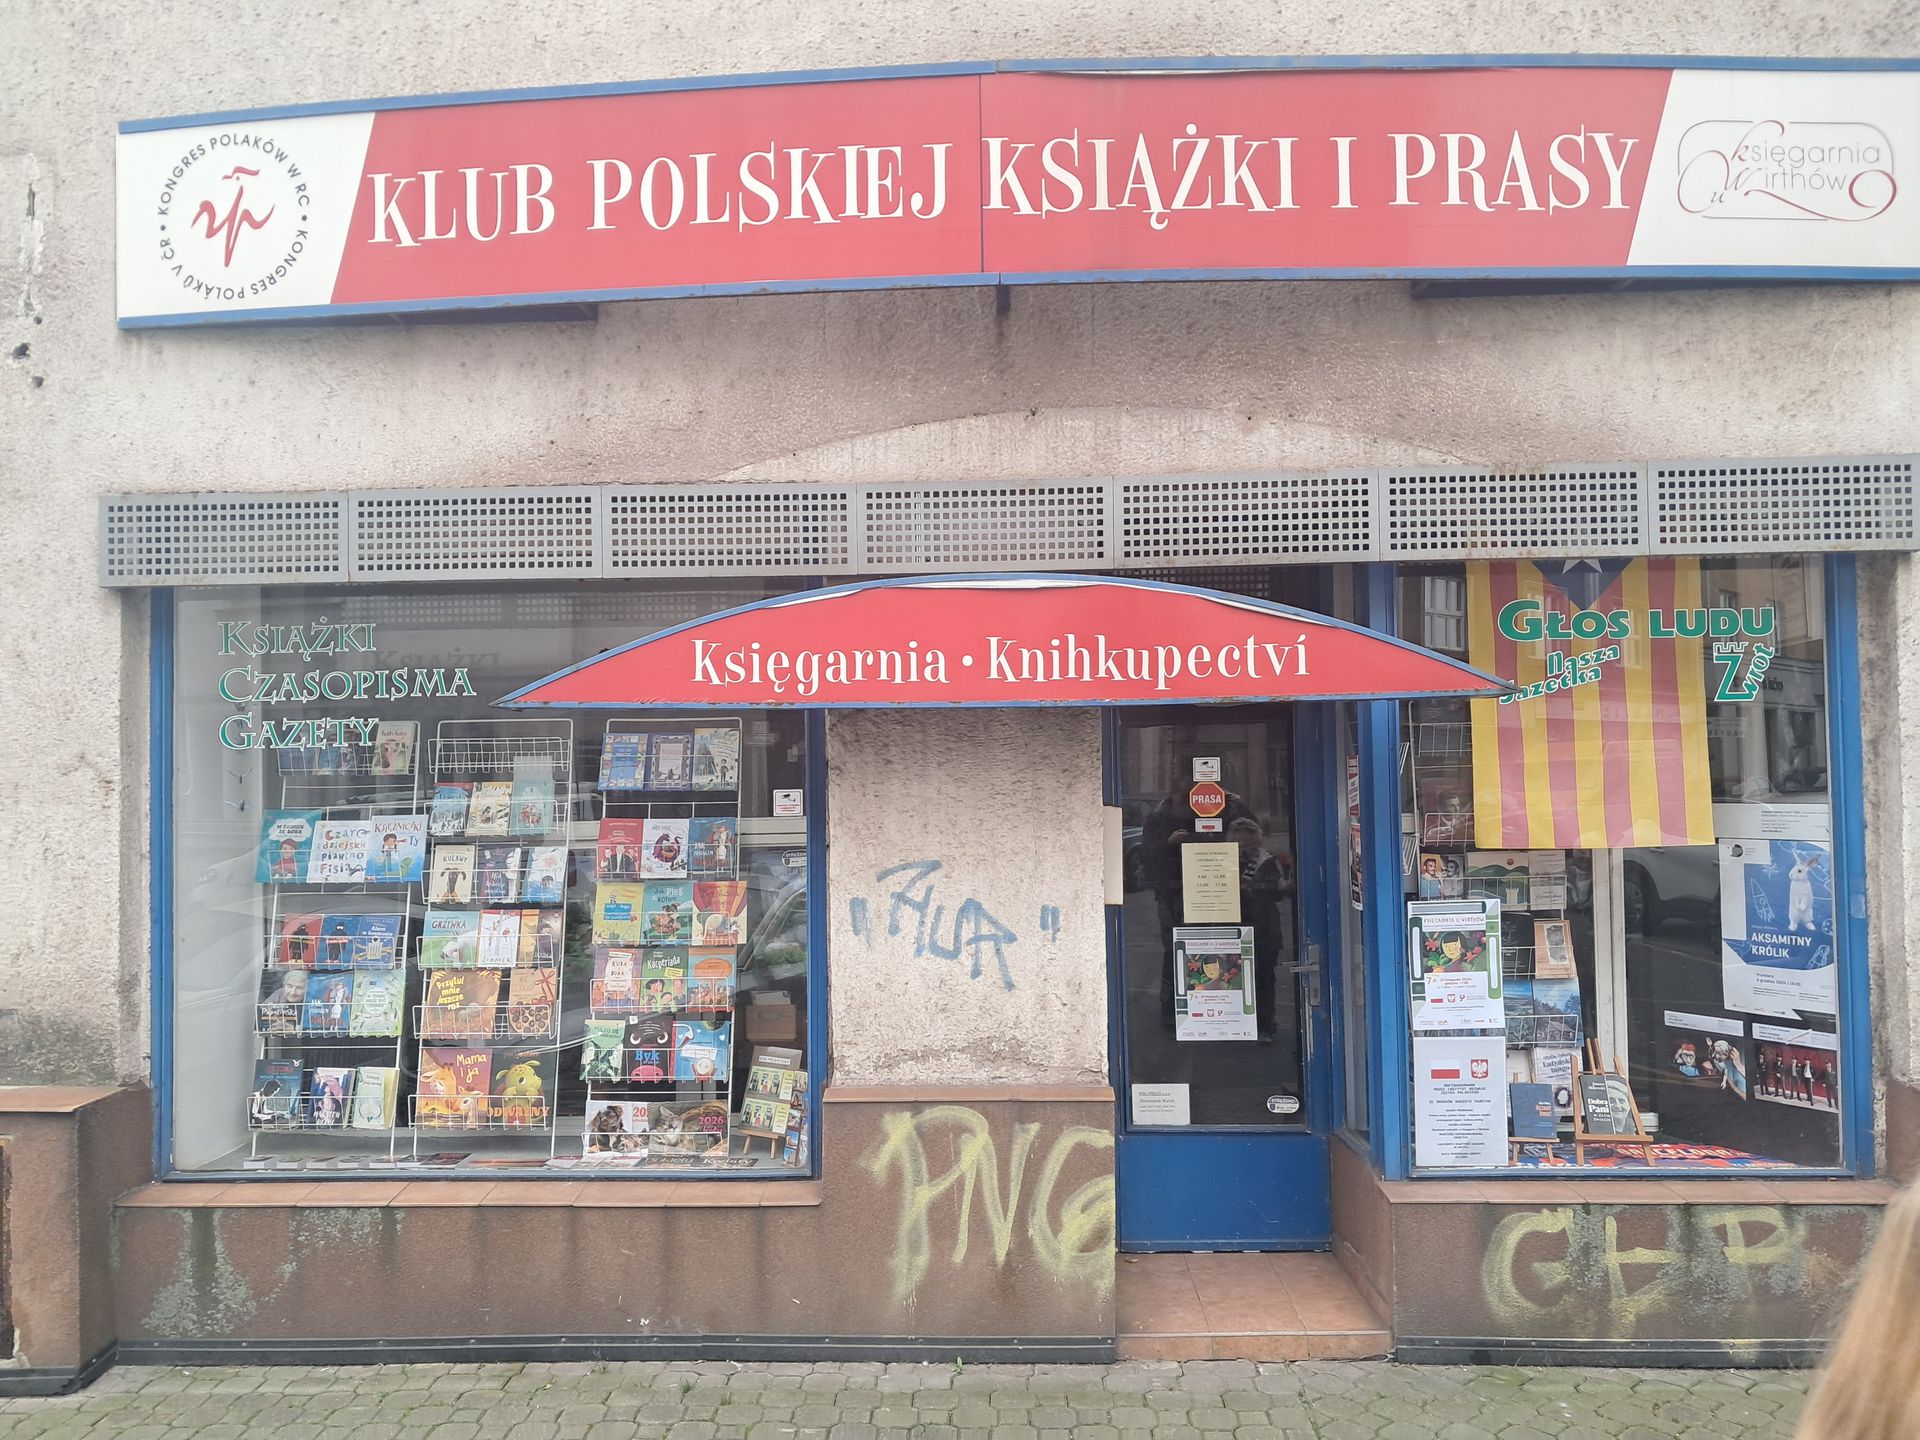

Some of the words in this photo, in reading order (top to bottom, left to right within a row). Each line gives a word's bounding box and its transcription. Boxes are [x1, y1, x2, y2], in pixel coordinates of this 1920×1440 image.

[1731, 120, 1880, 168] księgarnia
[158, 144, 206, 216] KONGRES
[209, 133, 288, 163] POLAKÓW
[287, 163, 301, 179] W
[295, 183, 310, 207] RC
[367, 163, 555, 247] KLUB
[586, 141, 953, 232] POLSKIEJ
[981, 123, 1301, 230] KSIĄŻKI
[1329, 136, 1359, 208] I
[1387, 124, 1640, 216] PRASY
[160, 237, 175, 261] ČR
[171, 264, 183, 276] V
[250, 229, 308, 295] KONGRES
[183, 275, 245, 300] POLÁKŮ
[1497, 598, 1632, 642] GŁOS
[1648, 607, 1775, 639] LUDU
[217, 616, 377, 662] KSIĄŻKI
[691, 640, 950, 696] Księgarnia
[986, 633, 1310, 690] Knihkupectví
[218, 664, 477, 704] CZASOPISMA
[219, 712, 379, 751] GAZETY
[1192, 795, 1222, 804] PRASA
[432, 920, 467, 930] GRZYWKA
[1751, 932, 1812, 948] AKSAMITNY
[1751, 945, 1790, 959] KRÓLIK
[647, 955, 681, 970] Kacperiada
[436, 976, 465, 990] Przytul
[441, 986, 460, 996] mnie
[436, 993, 465, 1006] jeszcze
[456, 1053, 487, 1067] Mama
[635, 1050, 660, 1062] Byk
[466, 1065, 480, 1083] ja
[1588, 1104, 1610, 1113] Pani
[698, 1116, 724, 1126] 2026
